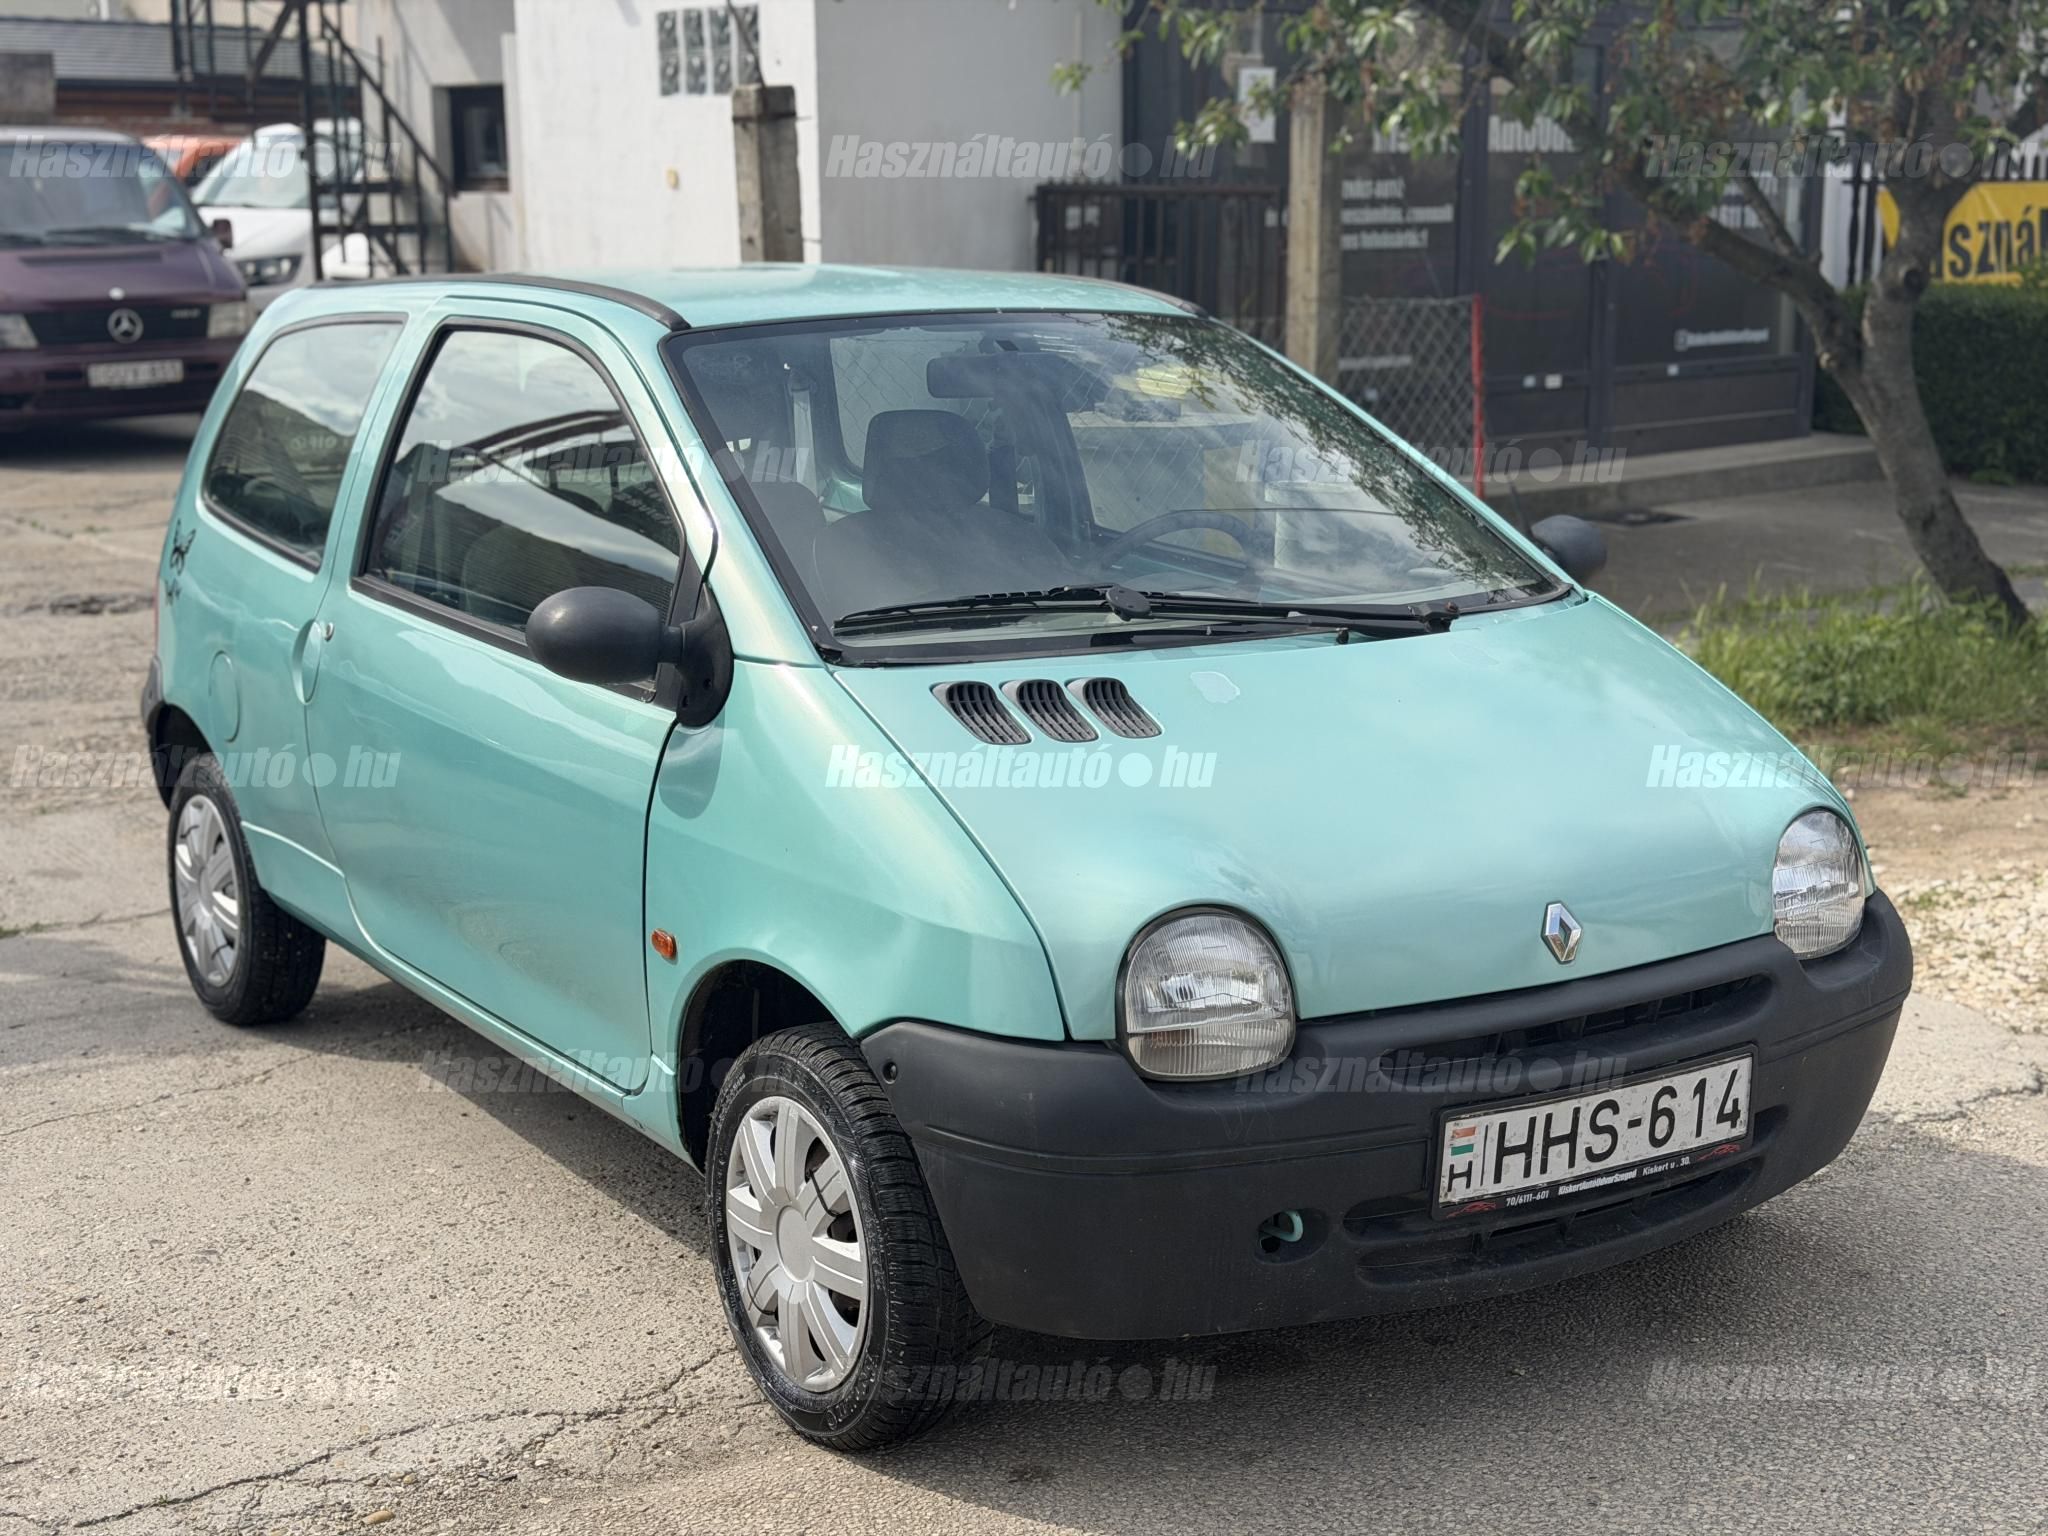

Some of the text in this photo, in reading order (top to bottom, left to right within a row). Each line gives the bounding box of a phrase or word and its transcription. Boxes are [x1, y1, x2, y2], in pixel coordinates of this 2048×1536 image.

[1494, 1068, 1741, 1184] HHS-614
[1447, 1160, 1473, 1193] H
[1643, 1162, 1669, 1176] Kiskert
